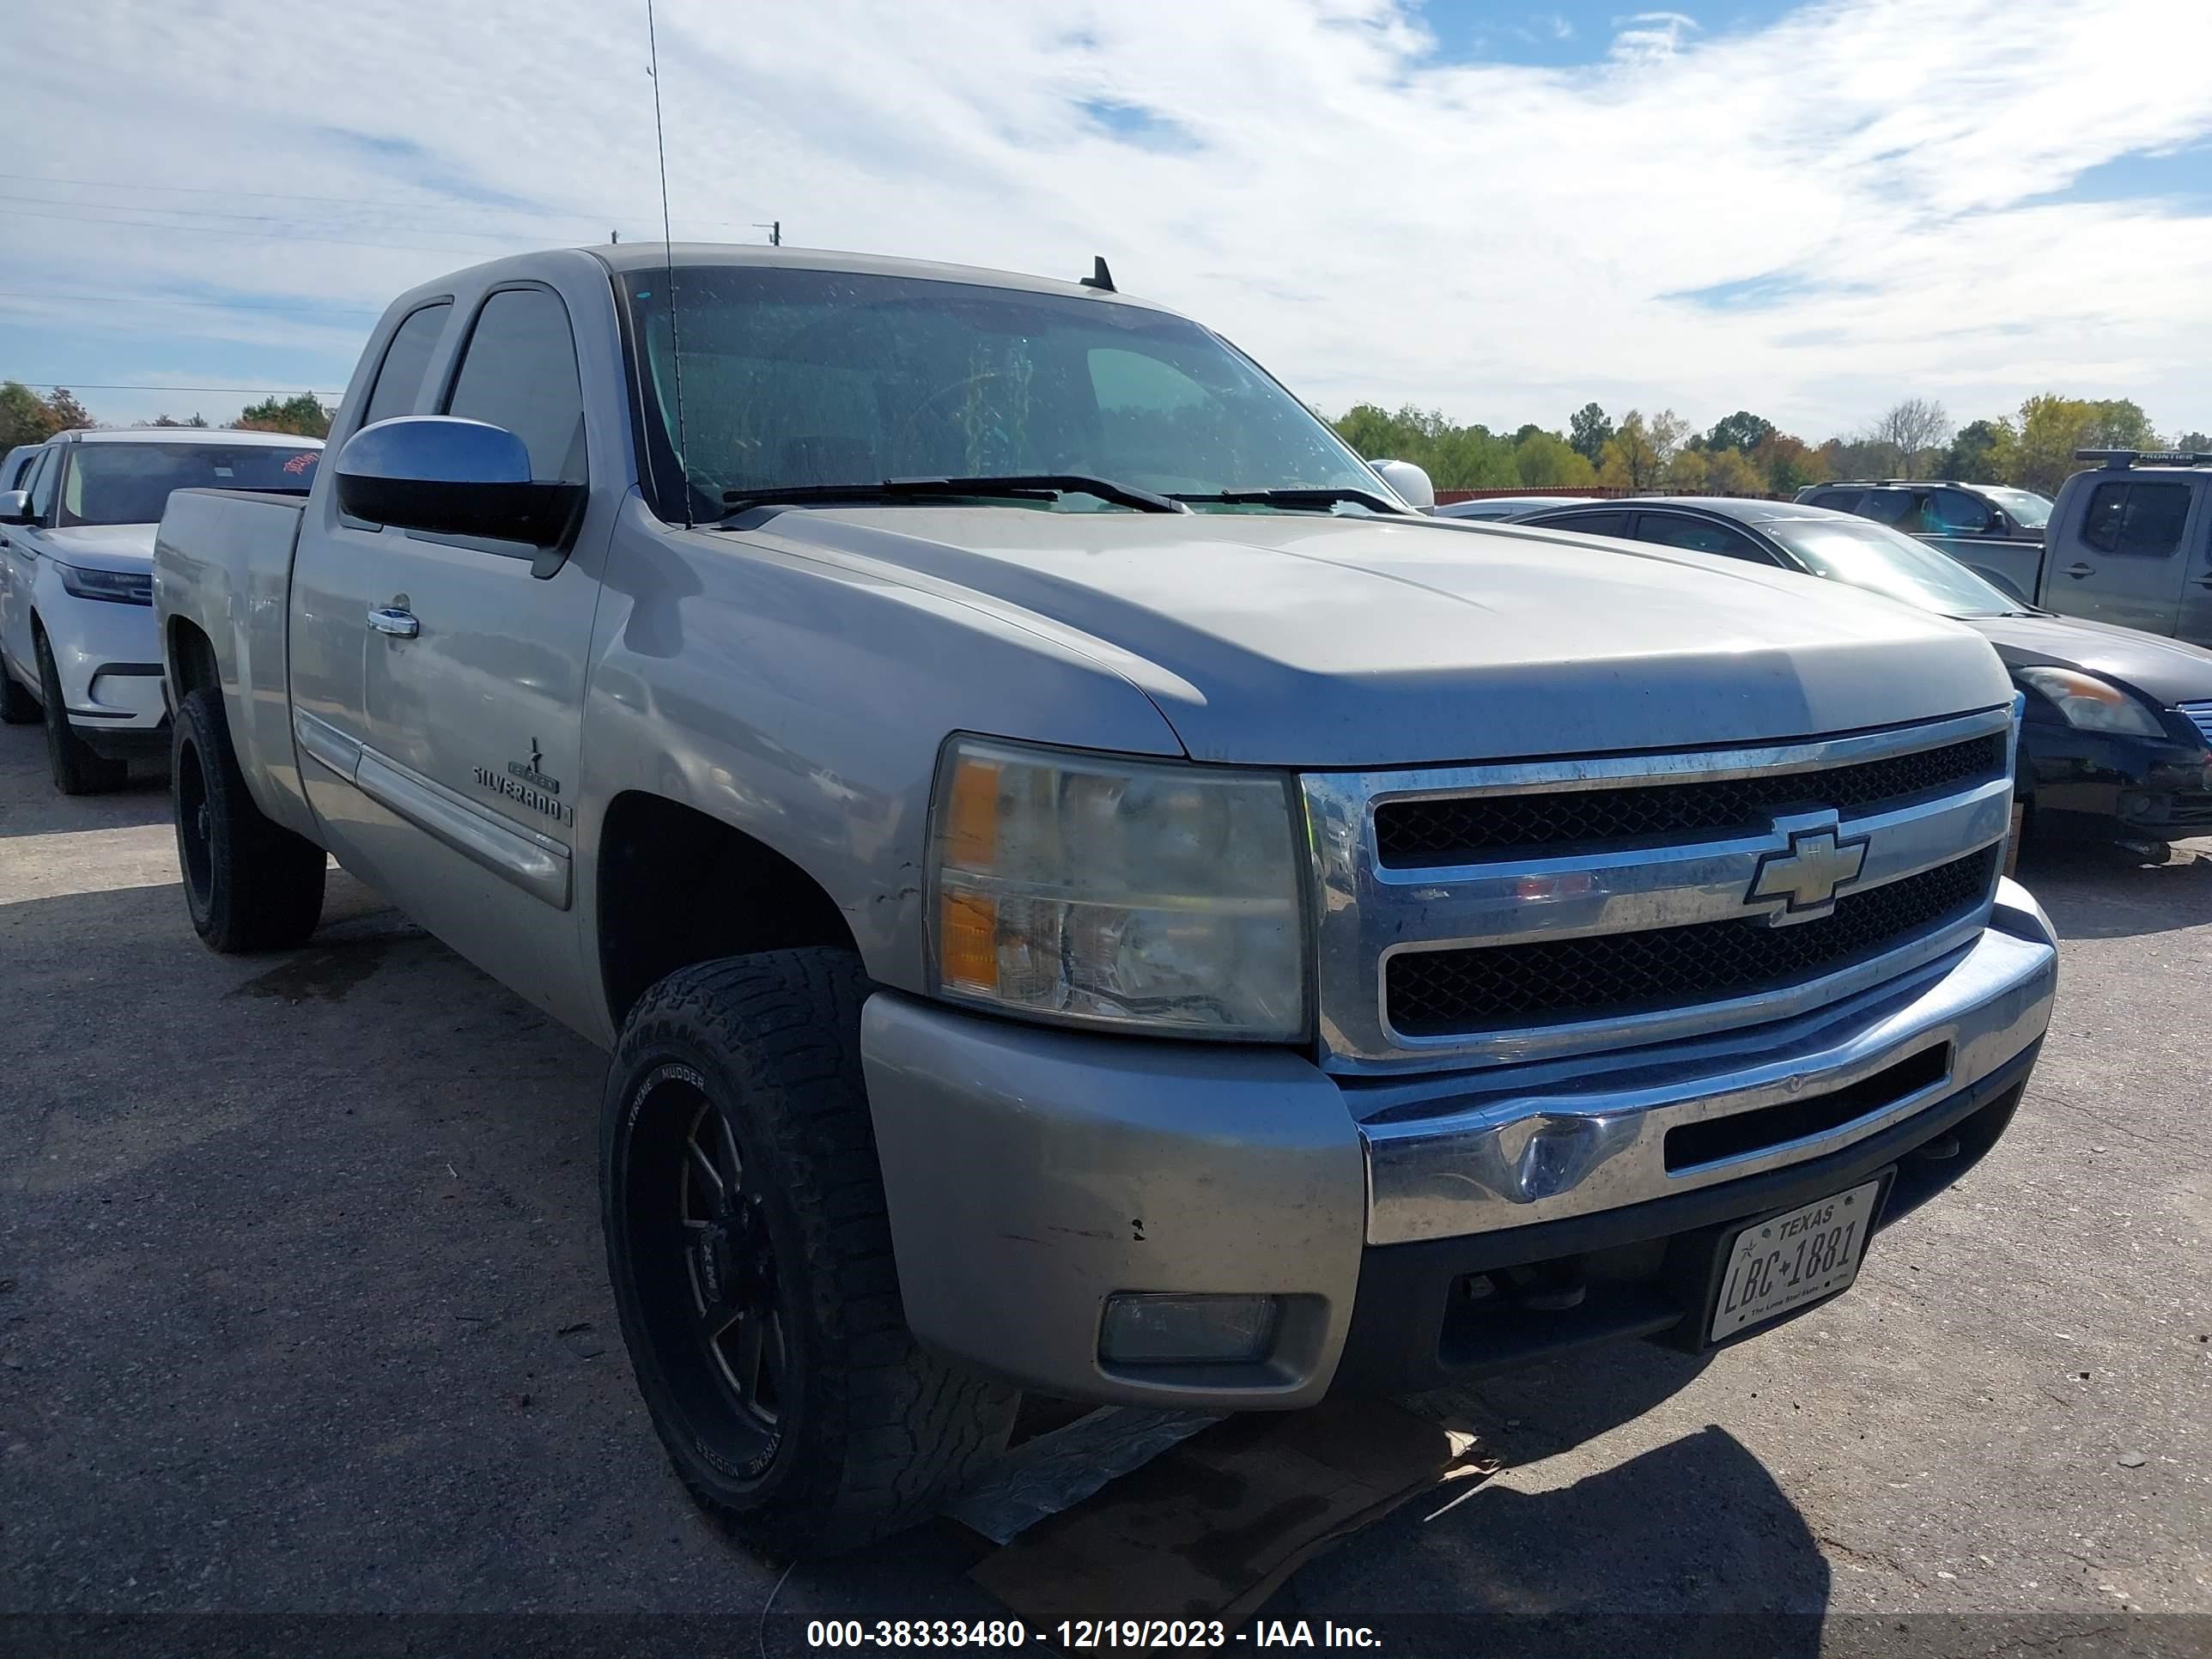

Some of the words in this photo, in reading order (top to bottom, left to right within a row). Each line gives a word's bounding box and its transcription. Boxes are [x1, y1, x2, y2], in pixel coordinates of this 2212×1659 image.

[2139, 453, 2194, 461] FRONTIER
[473, 765, 562, 821] SILVERADO
[661, 1066, 705, 1092] MUDDER
[1778, 1204, 1835, 1242] TEXAS
[1723, 1249, 1780, 1316] LBC
[1786, 1220, 1856, 1288] 1881
